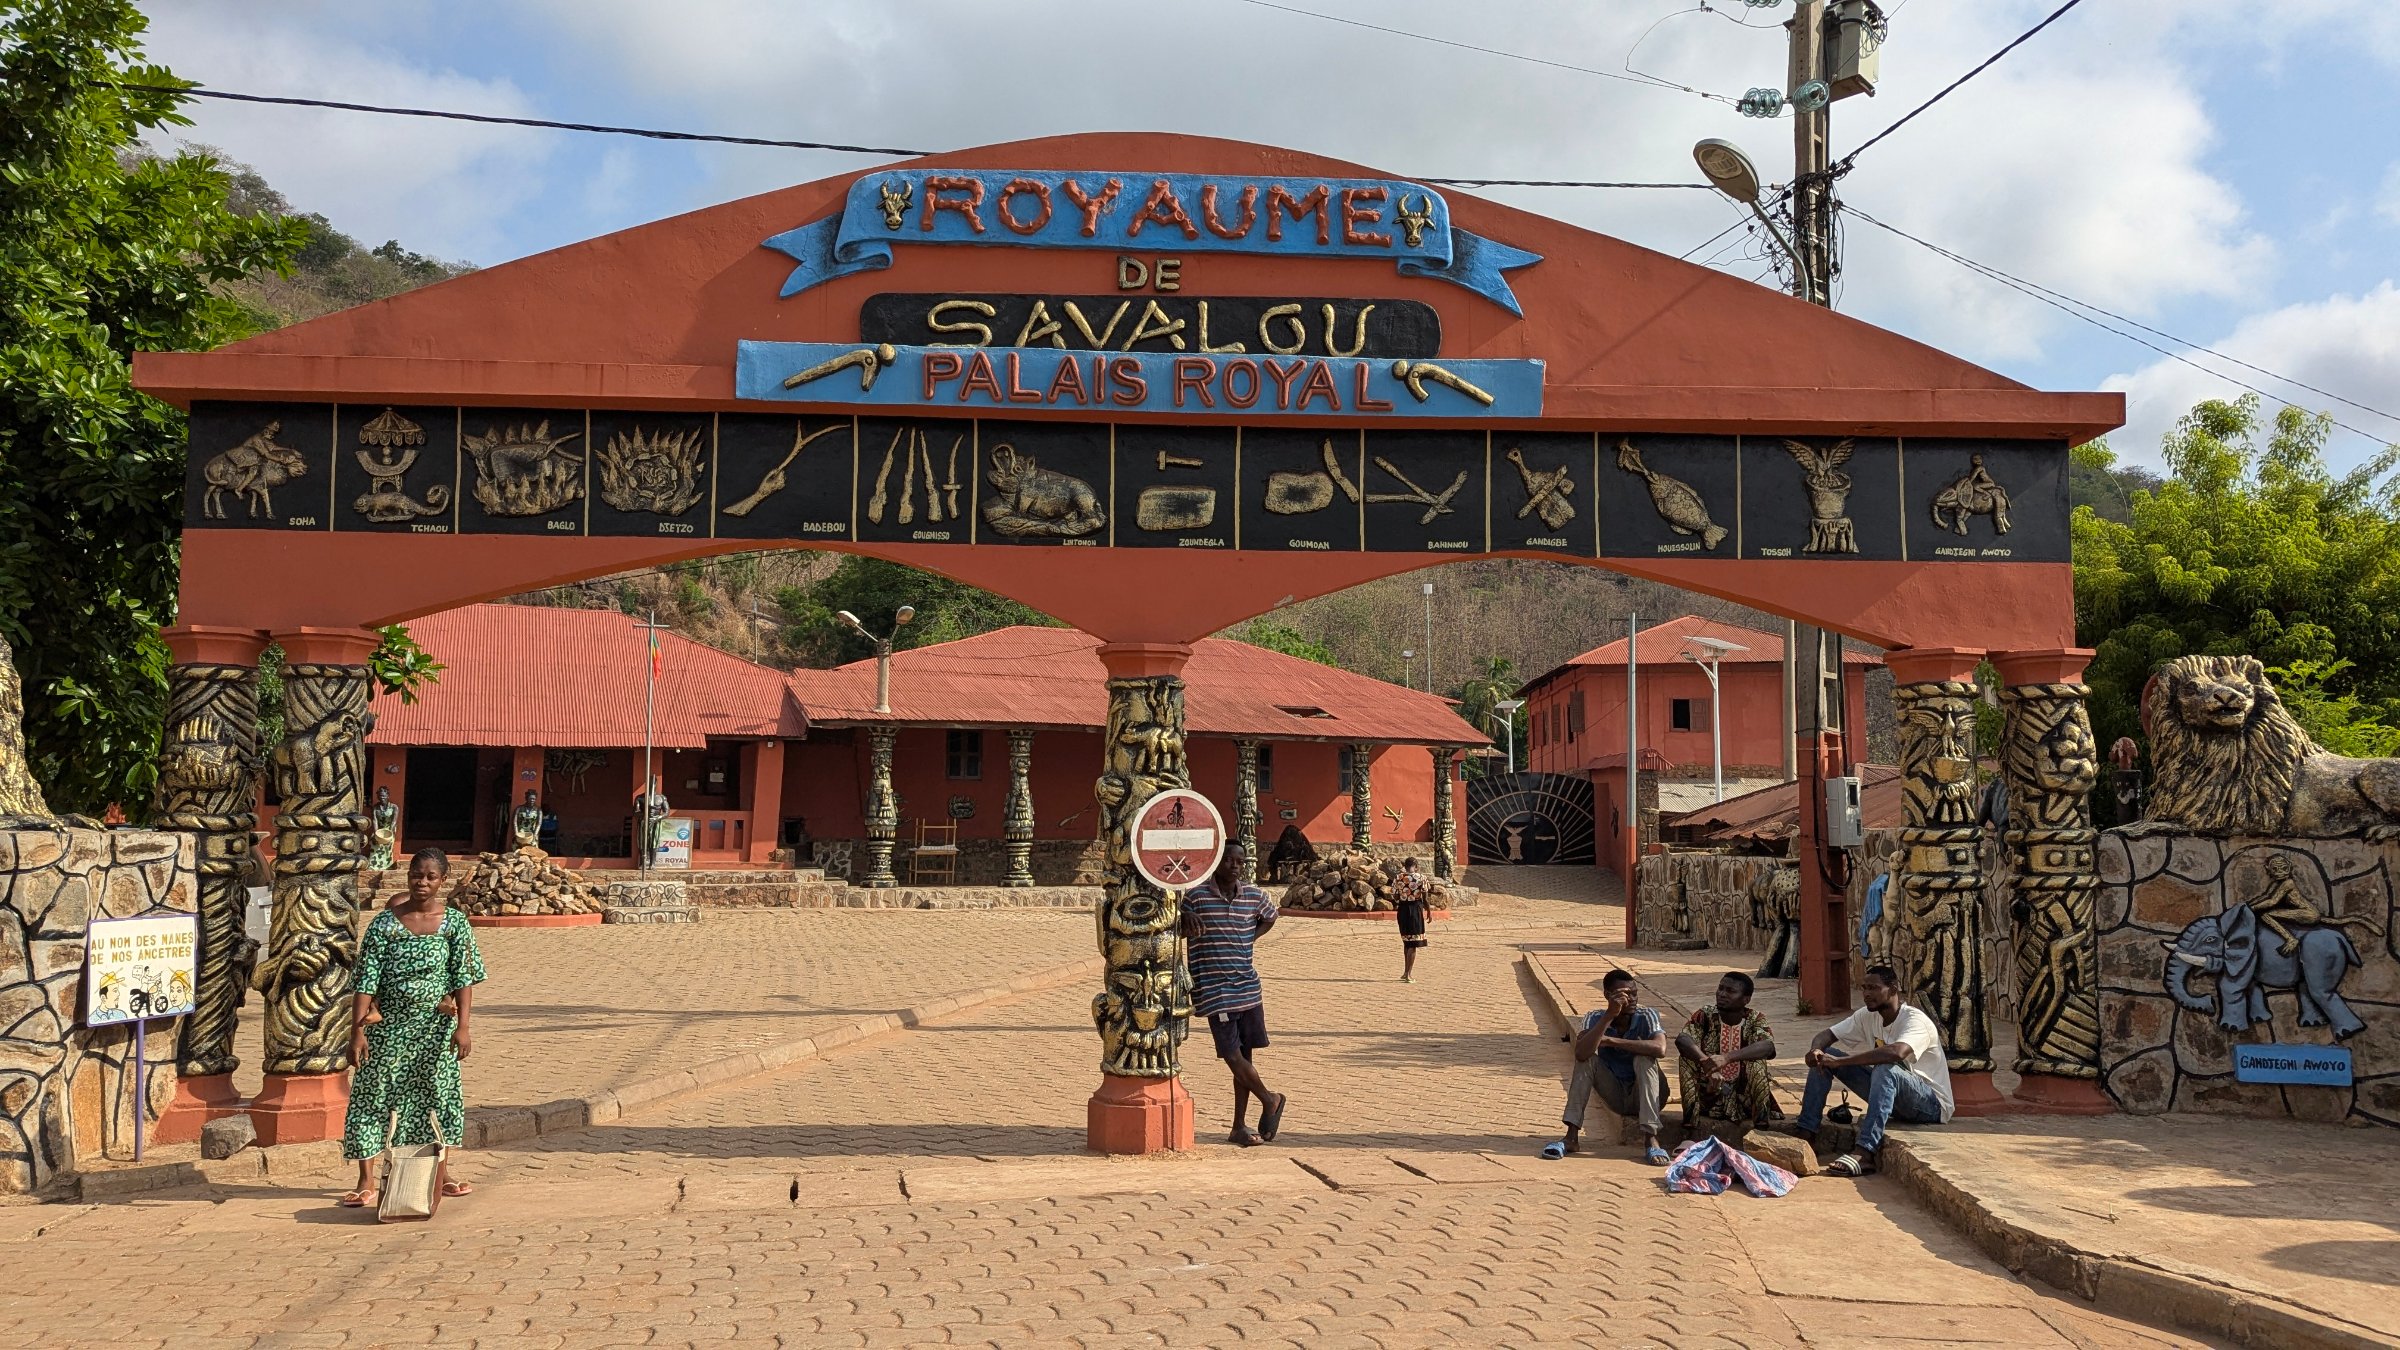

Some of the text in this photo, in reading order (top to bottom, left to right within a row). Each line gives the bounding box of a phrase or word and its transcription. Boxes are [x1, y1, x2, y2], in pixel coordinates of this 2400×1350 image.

[920, 176, 1393, 248] ROYAUME
[1117, 256, 1181, 291] DE
[926, 299, 1376, 357] SAVALOU
[922, 352, 1395, 412] PALAIS ROYAL
[289, 517, 316, 526] SOHA
[547, 520, 576, 531] BAGLO
[803, 522, 846, 532] BADEBOU
[411, 524, 448, 533] TCHAOU
[1179, 538, 1225, 547] ZOUNDEGLA
[1427, 541, 1469, 549] BAHINNOU
[1526, 538, 1568, 547] GANDIGBE
[1981, 548, 2012, 557] AWOYO
[91, 939, 105, 950] AU
[110, 937, 131, 949] NOM
[136, 935, 157, 947] DES
[90, 946, 192, 965] DE NOS ANCETRES
[2303, 1059, 2346, 1072] AWOYO
